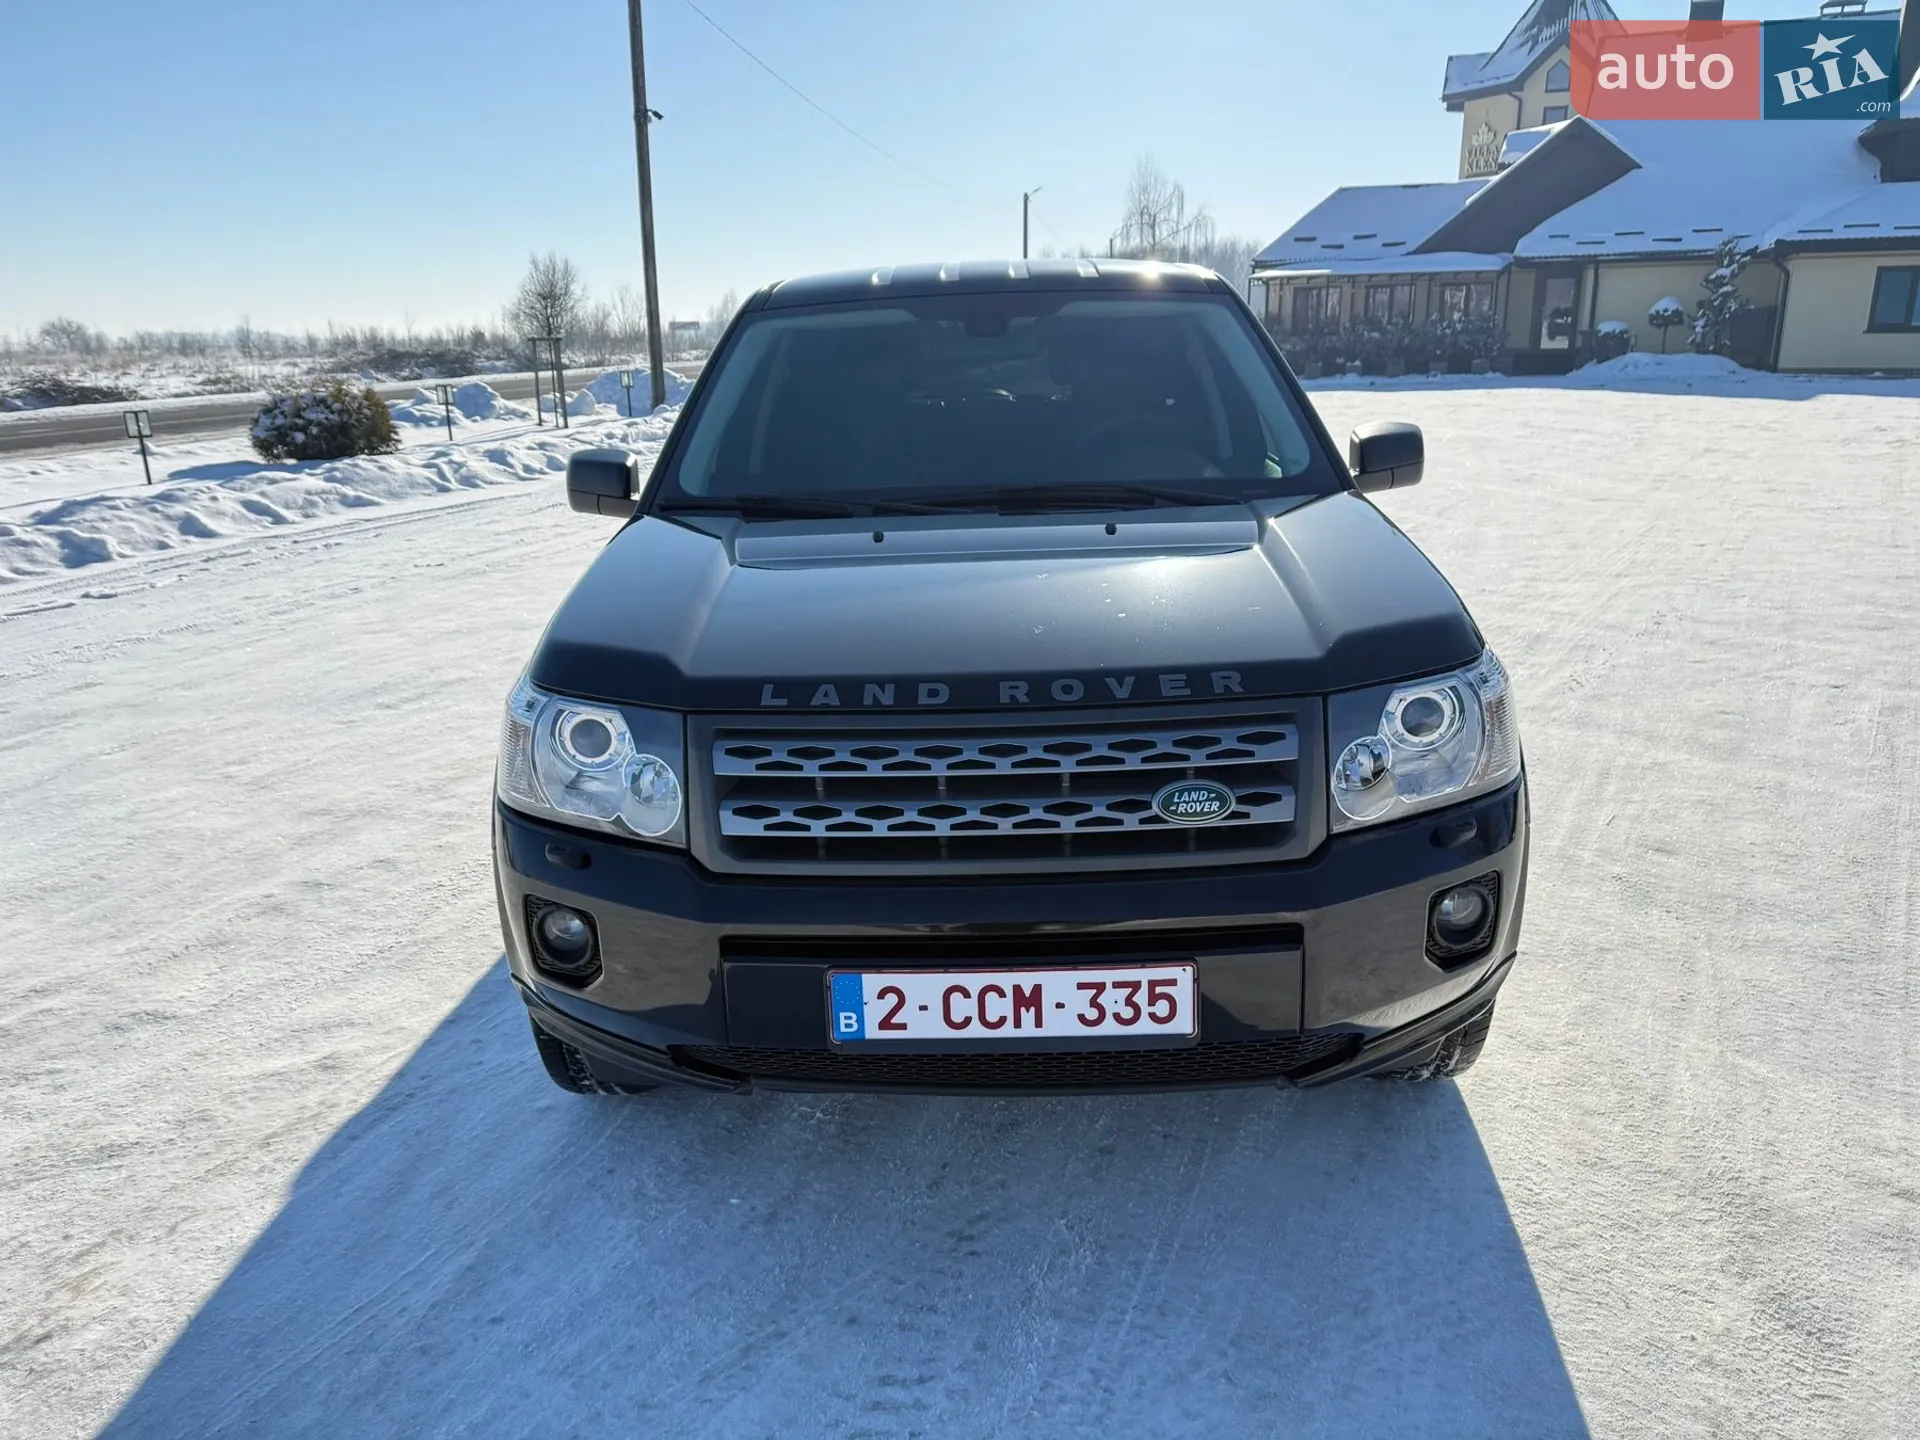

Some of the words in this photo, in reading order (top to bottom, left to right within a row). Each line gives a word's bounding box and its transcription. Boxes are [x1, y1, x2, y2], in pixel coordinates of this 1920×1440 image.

[760, 682, 951, 706] LAND
[999, 670, 1245, 703] ROVER
[1173, 791, 1208, 802] LAND
[1177, 801, 1220, 814] ROVER
[839, 1012, 859, 1033] B
